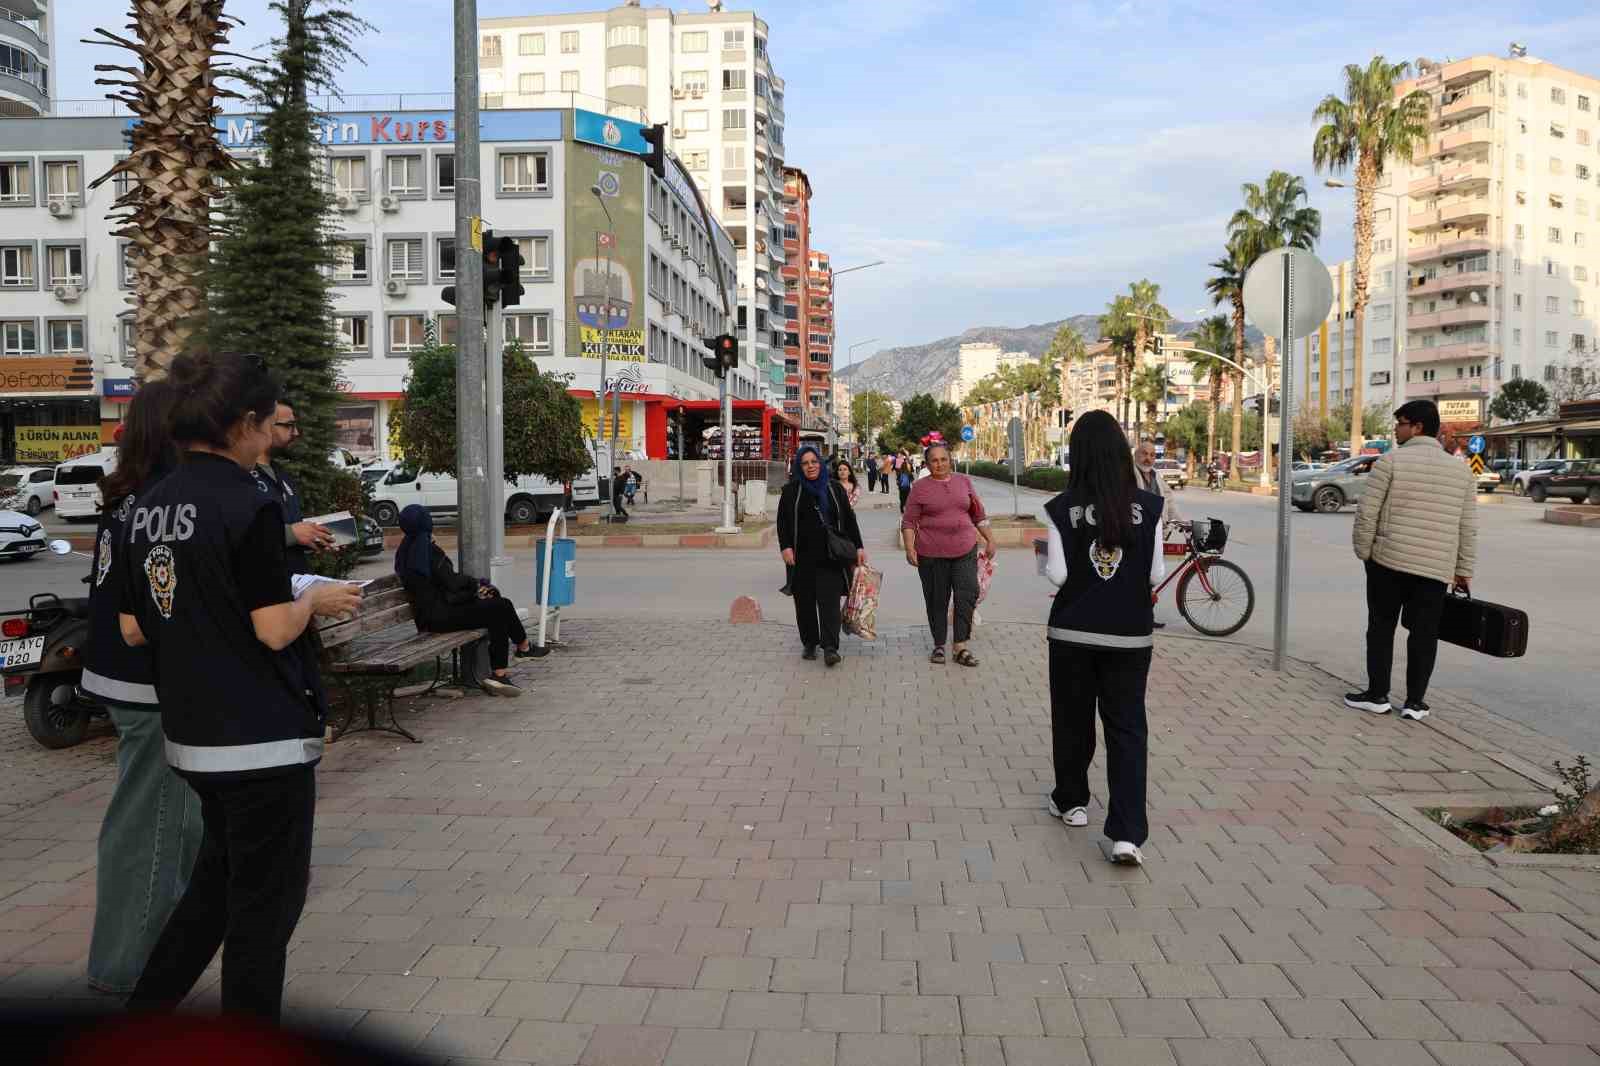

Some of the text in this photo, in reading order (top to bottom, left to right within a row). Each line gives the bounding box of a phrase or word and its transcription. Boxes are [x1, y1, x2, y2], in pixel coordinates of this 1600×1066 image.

[371, 115, 448, 142] Kurs
[597, 328, 641, 338] KRTARAN
[27, 429, 59, 441] ÜRÜN
[62, 431, 99, 441] ALANA
[1069, 503, 1143, 528] POS
[1, 642, 14, 653] 01
[7, 652, 30, 665] 820
